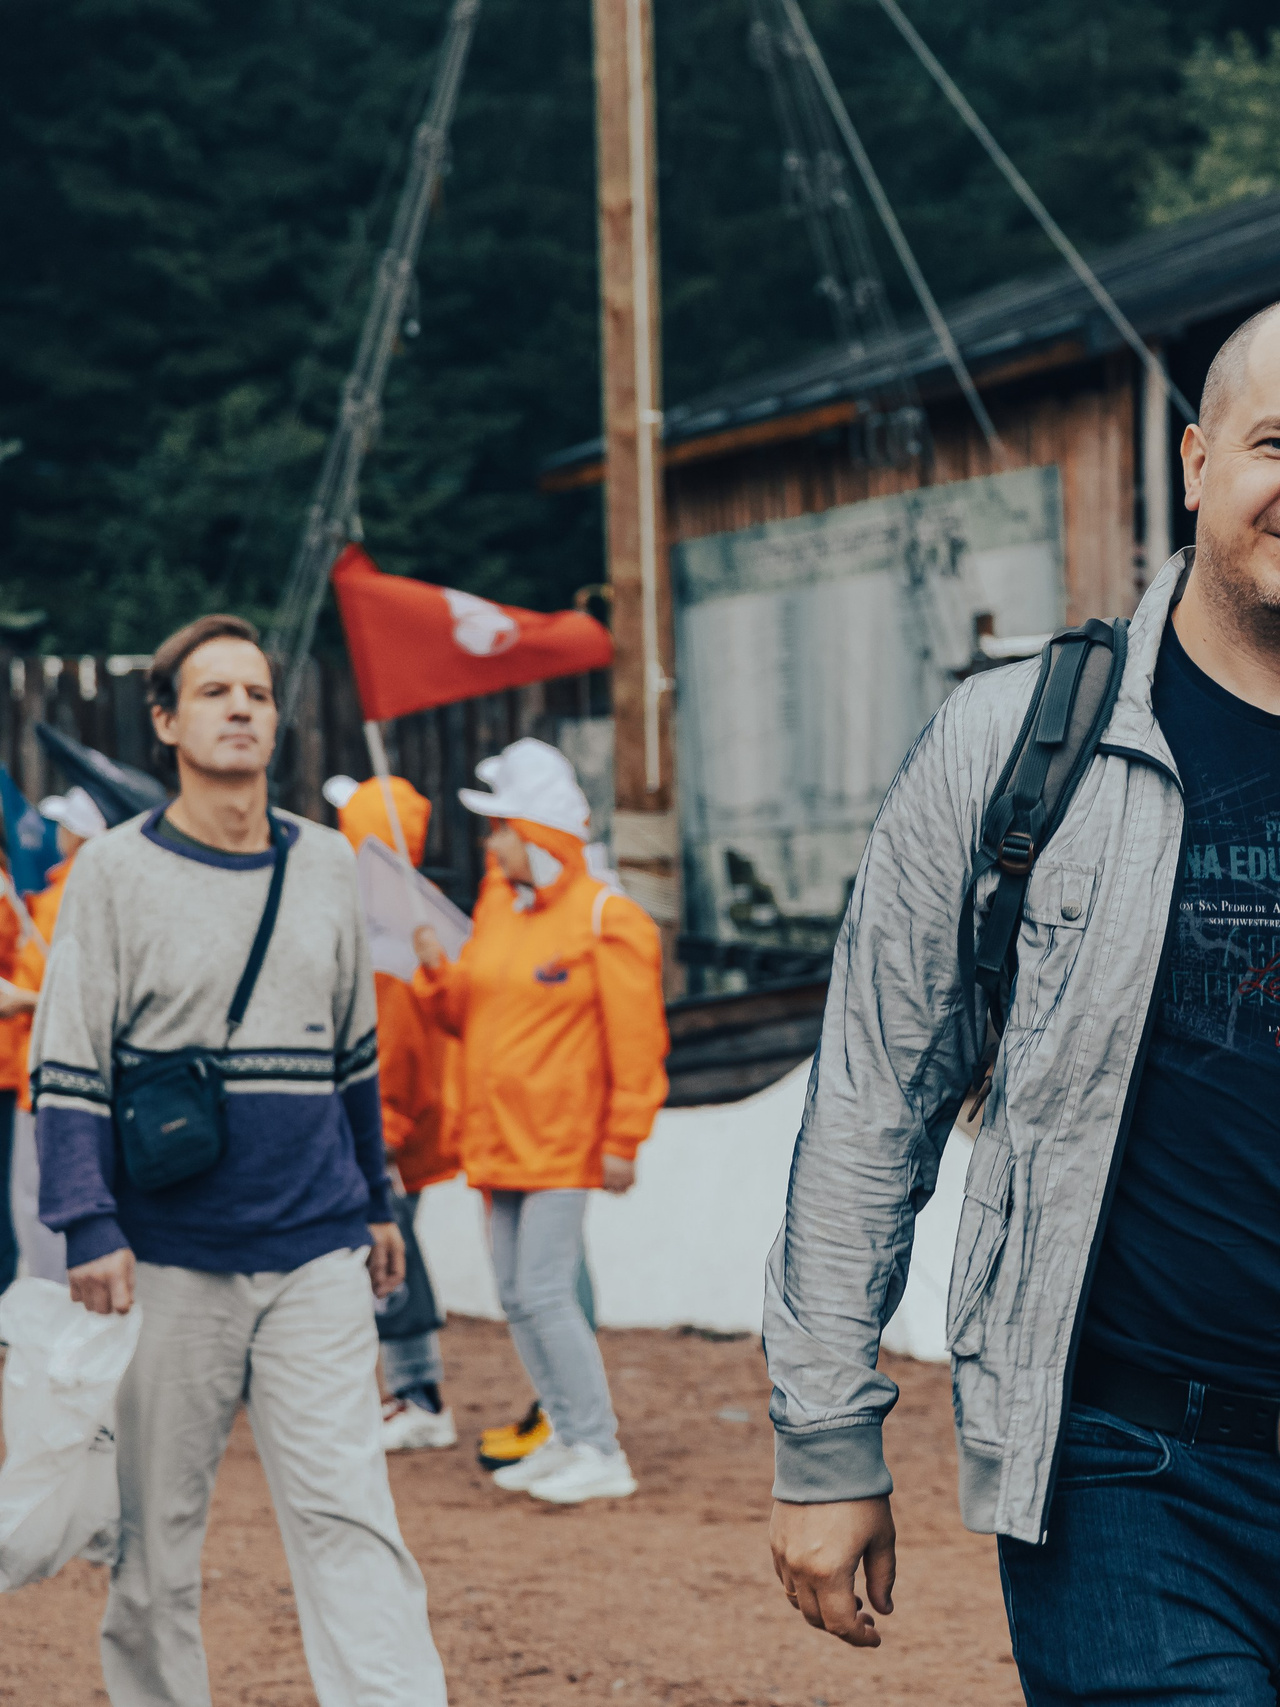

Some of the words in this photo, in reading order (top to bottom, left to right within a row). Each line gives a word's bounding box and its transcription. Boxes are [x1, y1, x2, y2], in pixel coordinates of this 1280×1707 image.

[1198, 900, 1218, 911] SAN
[1221, 900, 1253, 913] PEDRO
[1255, 904, 1267, 914] DE
